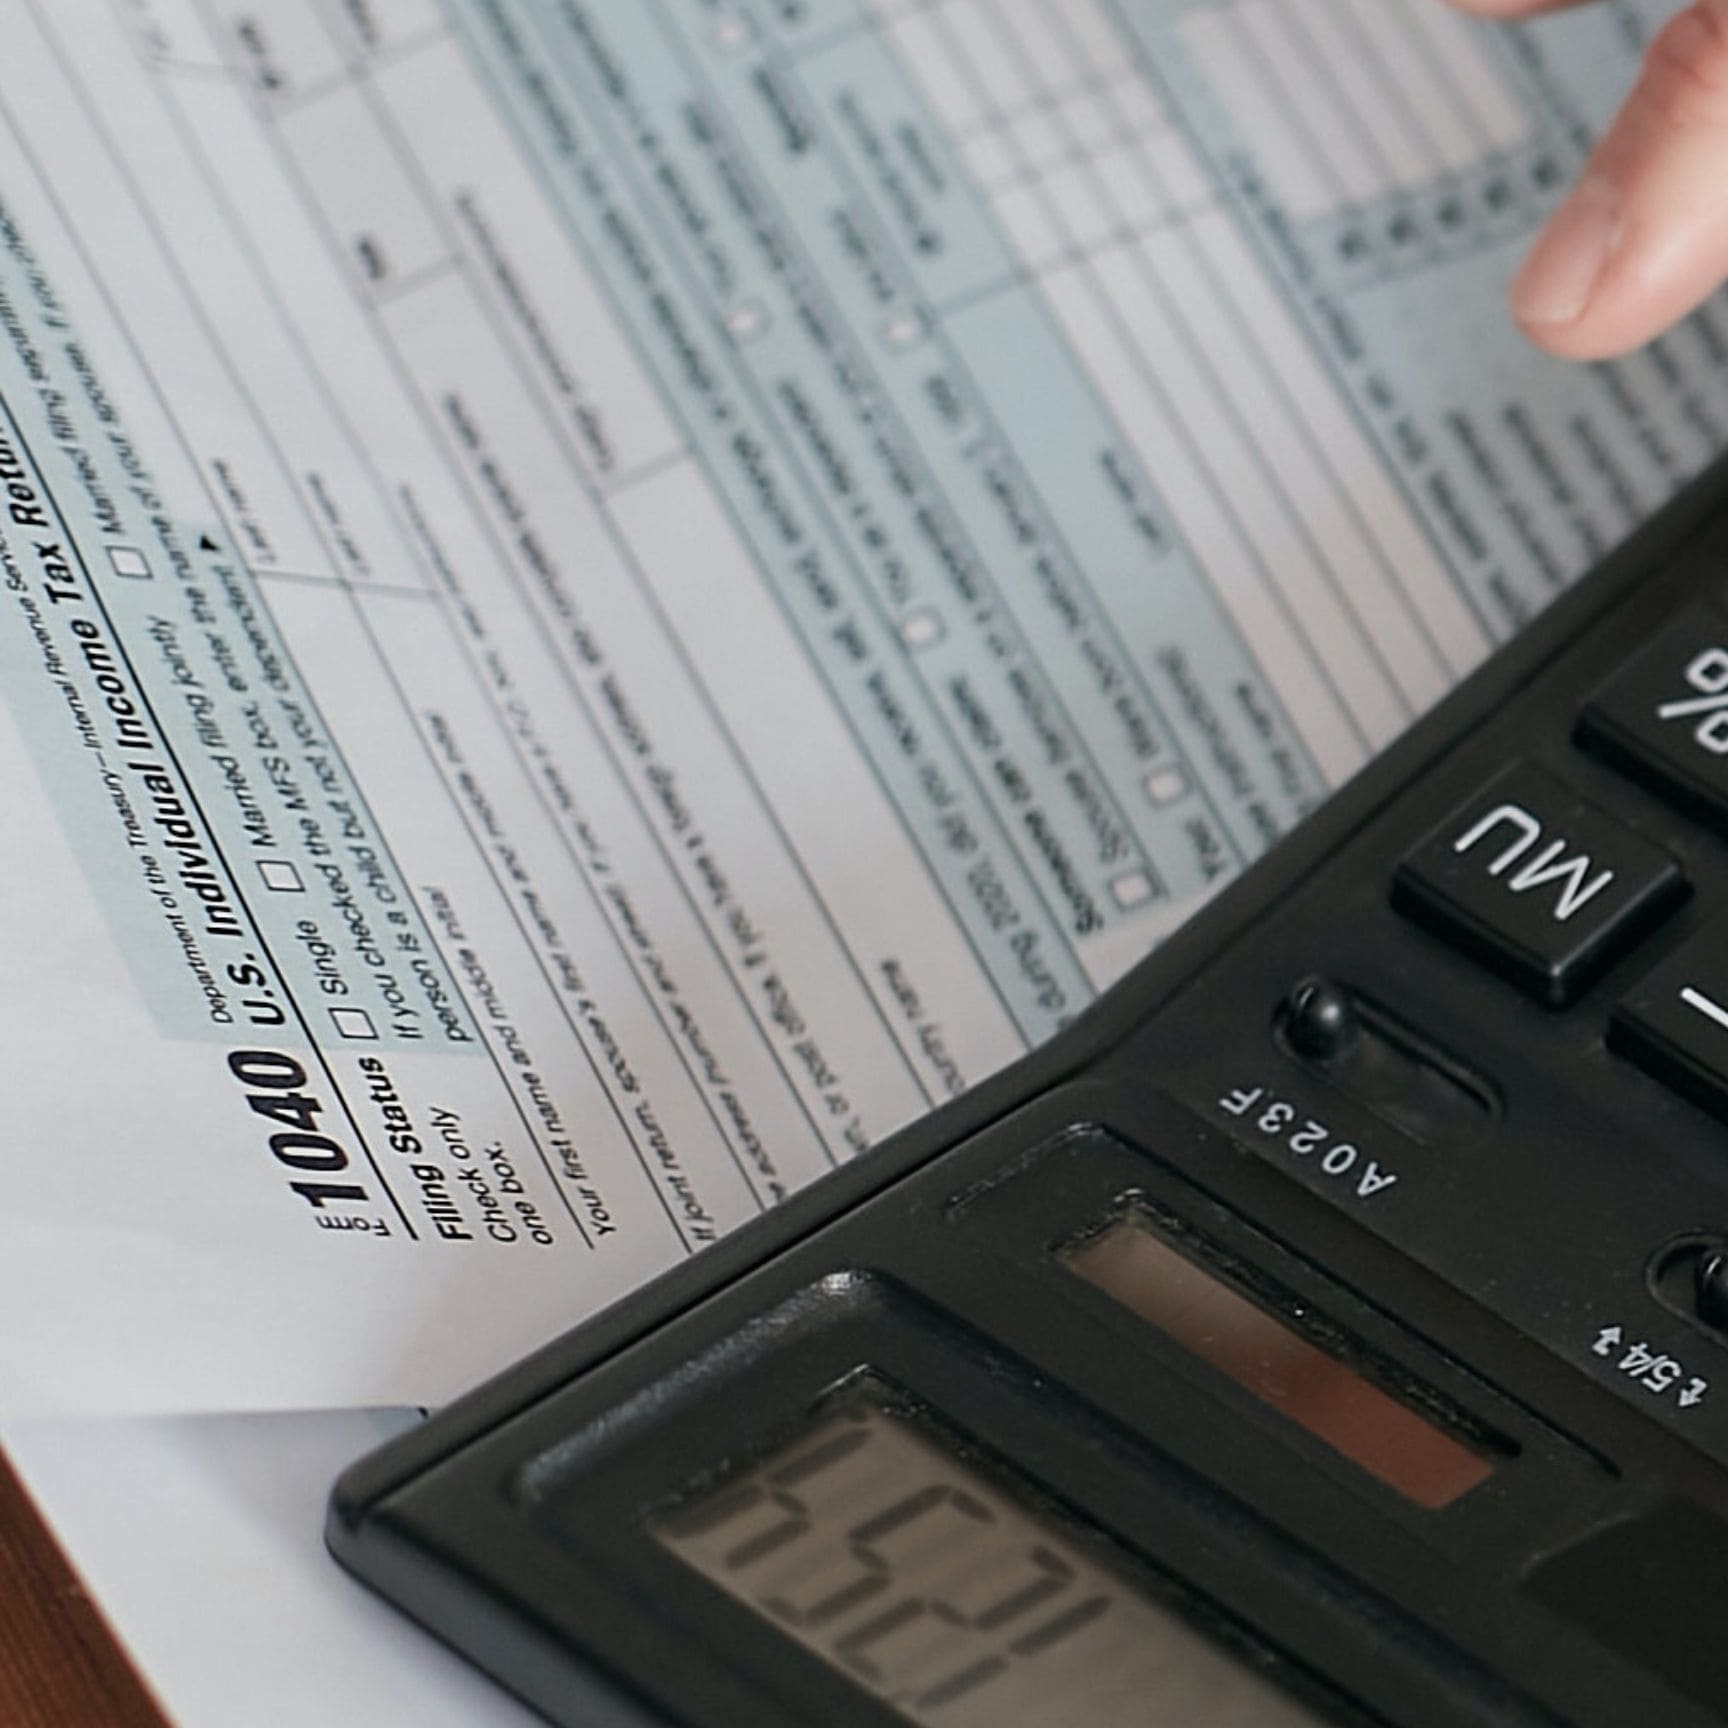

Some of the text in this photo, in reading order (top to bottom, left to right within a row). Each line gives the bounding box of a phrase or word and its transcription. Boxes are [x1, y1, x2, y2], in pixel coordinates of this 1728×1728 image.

[61, 446, 122, 534] Married
[150, 515, 190, 579] name
[184, 586, 216, 623] the
[18, 596, 67, 676] Revenue
[204, 632, 248, 692] enter
[0, 438, 286, 1025] U.S. Individual Income Tax Retu
[147, 615, 276, 847] Married filing jointly
[277, 699, 324, 748] your
[261, 756, 308, 810] MFS
[304, 755, 340, 792] not
[298, 817, 331, 856] the
[326, 800, 365, 839] but
[140, 855, 166, 884] the
[347, 845, 397, 903] child
[1454, 804, 1614, 921] MU
[150, 888, 177, 909] of
[313, 862, 385, 967] checked
[386, 911, 408, 925] a
[164, 913, 234, 1023] Department
[295, 920, 348, 995] Single
[396, 932, 421, 952] is
[373, 973, 419, 1017] you
[409, 958, 474, 1042] person
[391, 1024, 423, 1039] If
[422, 886, 616, 1236] Your first name and middle initial
[226, 1050, 369, 1208] 1040
[357, 1057, 473, 1240] Filing Status
[429, 1106, 517, 1242] Check only
[484, 1141, 553, 1245] one box.
[666, 1175, 713, 1222] joint
[315, 1216, 391, 1237] Form
[690, 1226, 723, 1245] If
